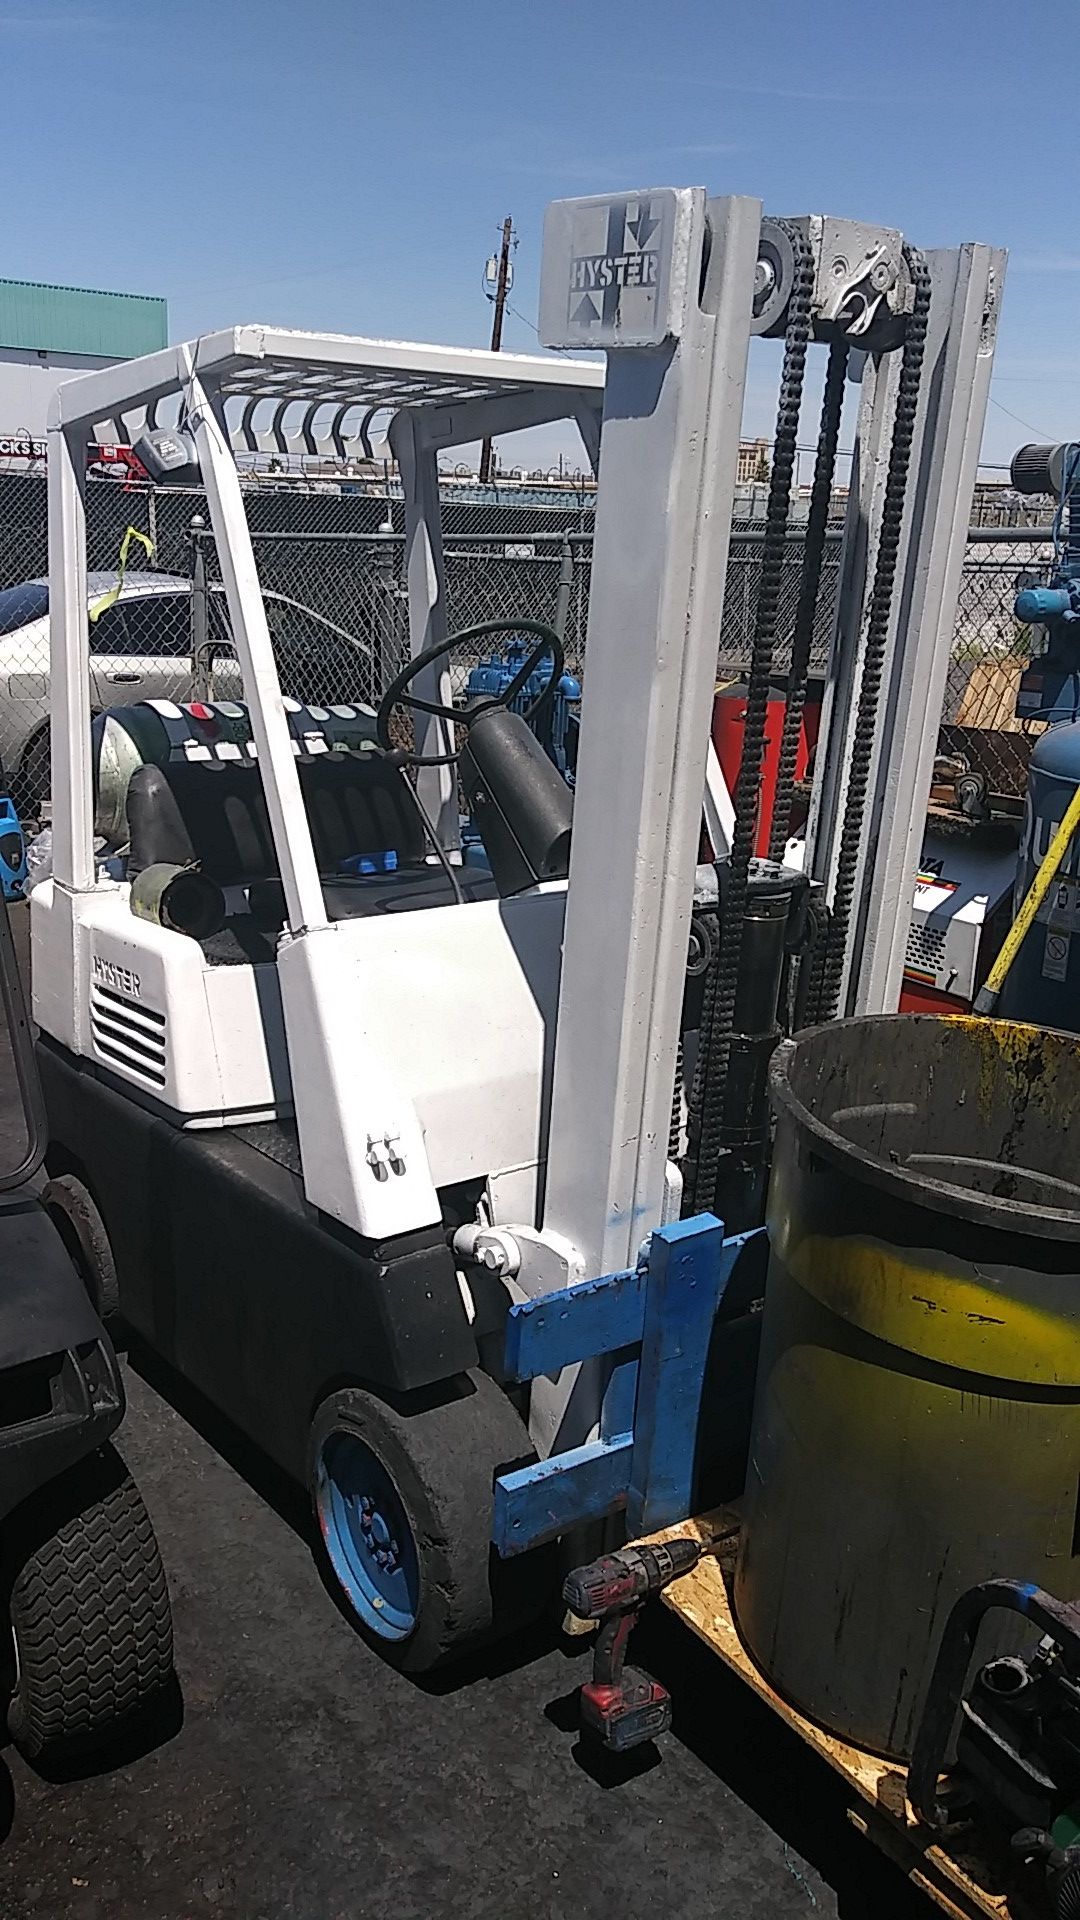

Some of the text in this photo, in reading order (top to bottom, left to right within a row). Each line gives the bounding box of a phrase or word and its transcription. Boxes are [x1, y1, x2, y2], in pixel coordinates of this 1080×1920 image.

[571, 254, 658, 288] HYSTER
[33, 442, 49, 456] SI
[92, 955, 141, 998] HYSTER
